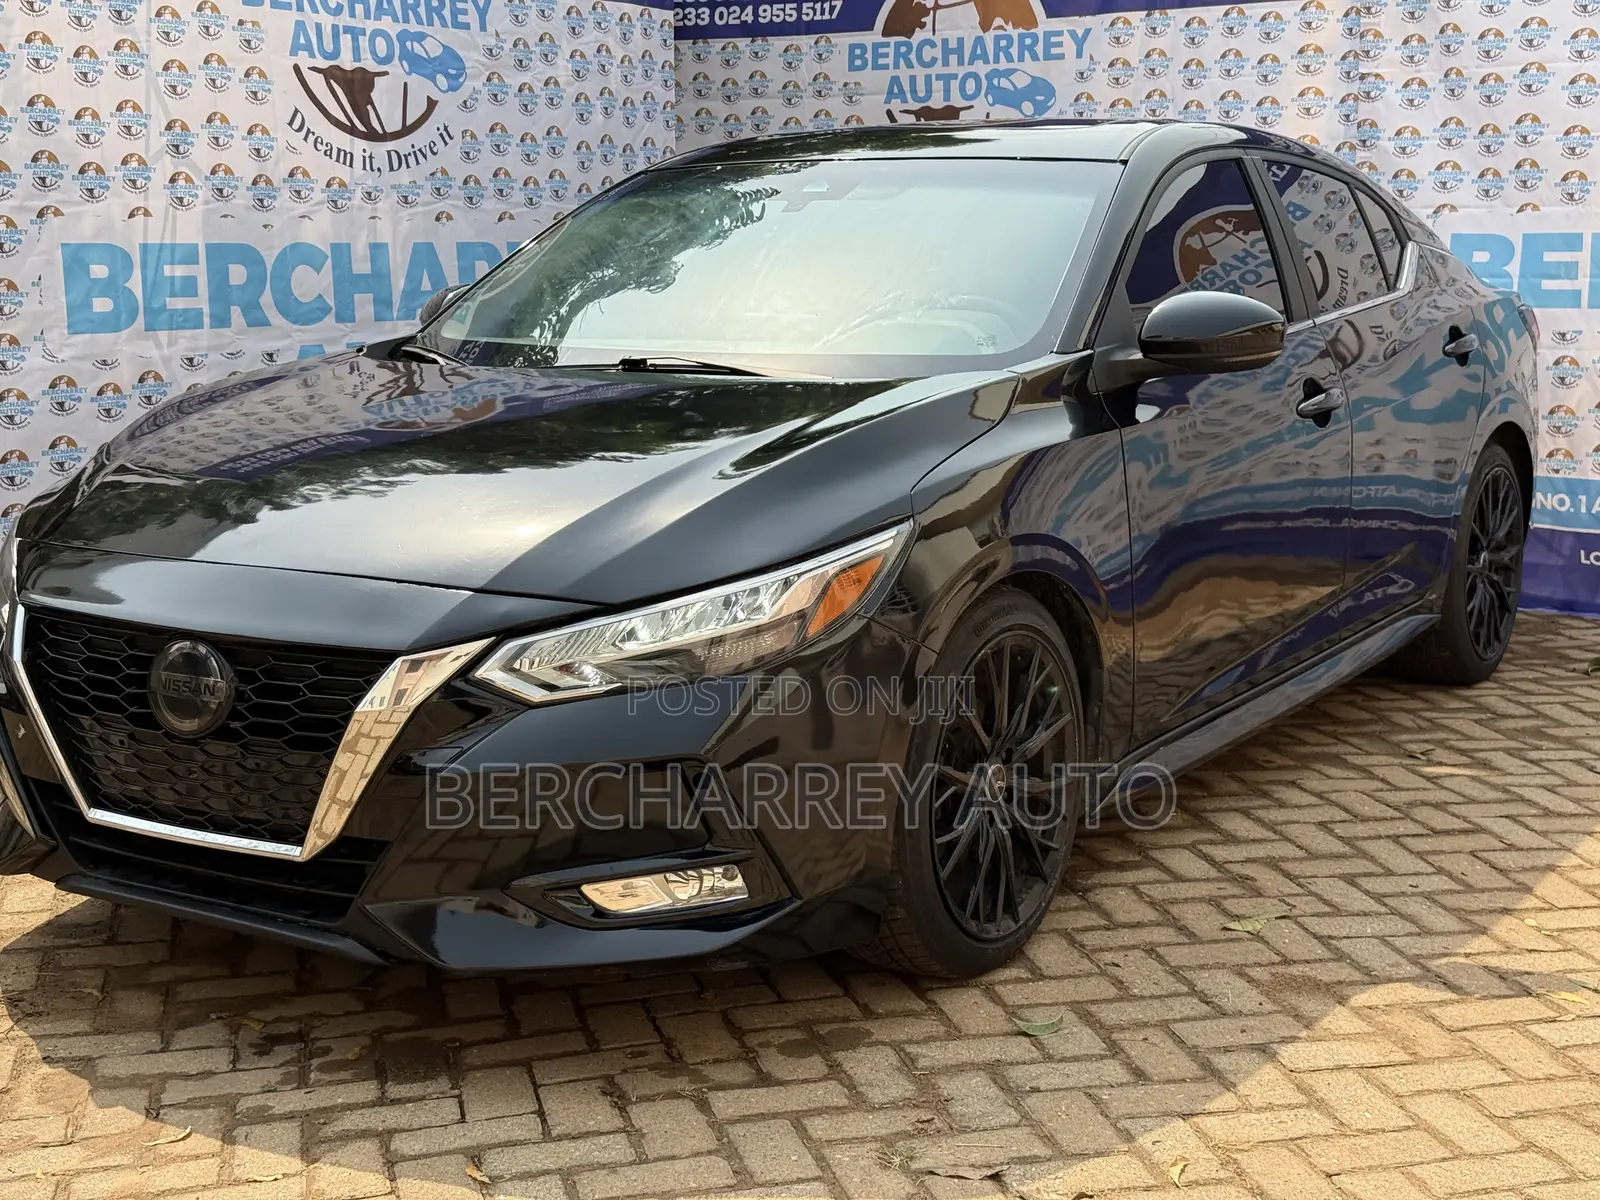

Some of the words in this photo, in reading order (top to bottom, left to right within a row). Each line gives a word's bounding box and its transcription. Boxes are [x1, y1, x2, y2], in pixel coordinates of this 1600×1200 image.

[241, 0, 492, 32] CHARREY
[674, 8, 710, 26] 233
[714, 5, 754, 26] 024
[758, 3, 798, 24] 955
[802, 1, 843, 22] 5117
[289, 20, 395, 65] AUTO
[847, 28, 1093, 72] BERCHARREY
[884, 71, 982, 105] AUTO
[286, 105, 354, 170] Dream
[361, 149, 382, 177] it,
[387, 139, 439, 173] Drive
[437, 121, 455, 149] it
[1535, 491, 1575, 513] NO.
[161, 676, 216, 697] NISSAN
